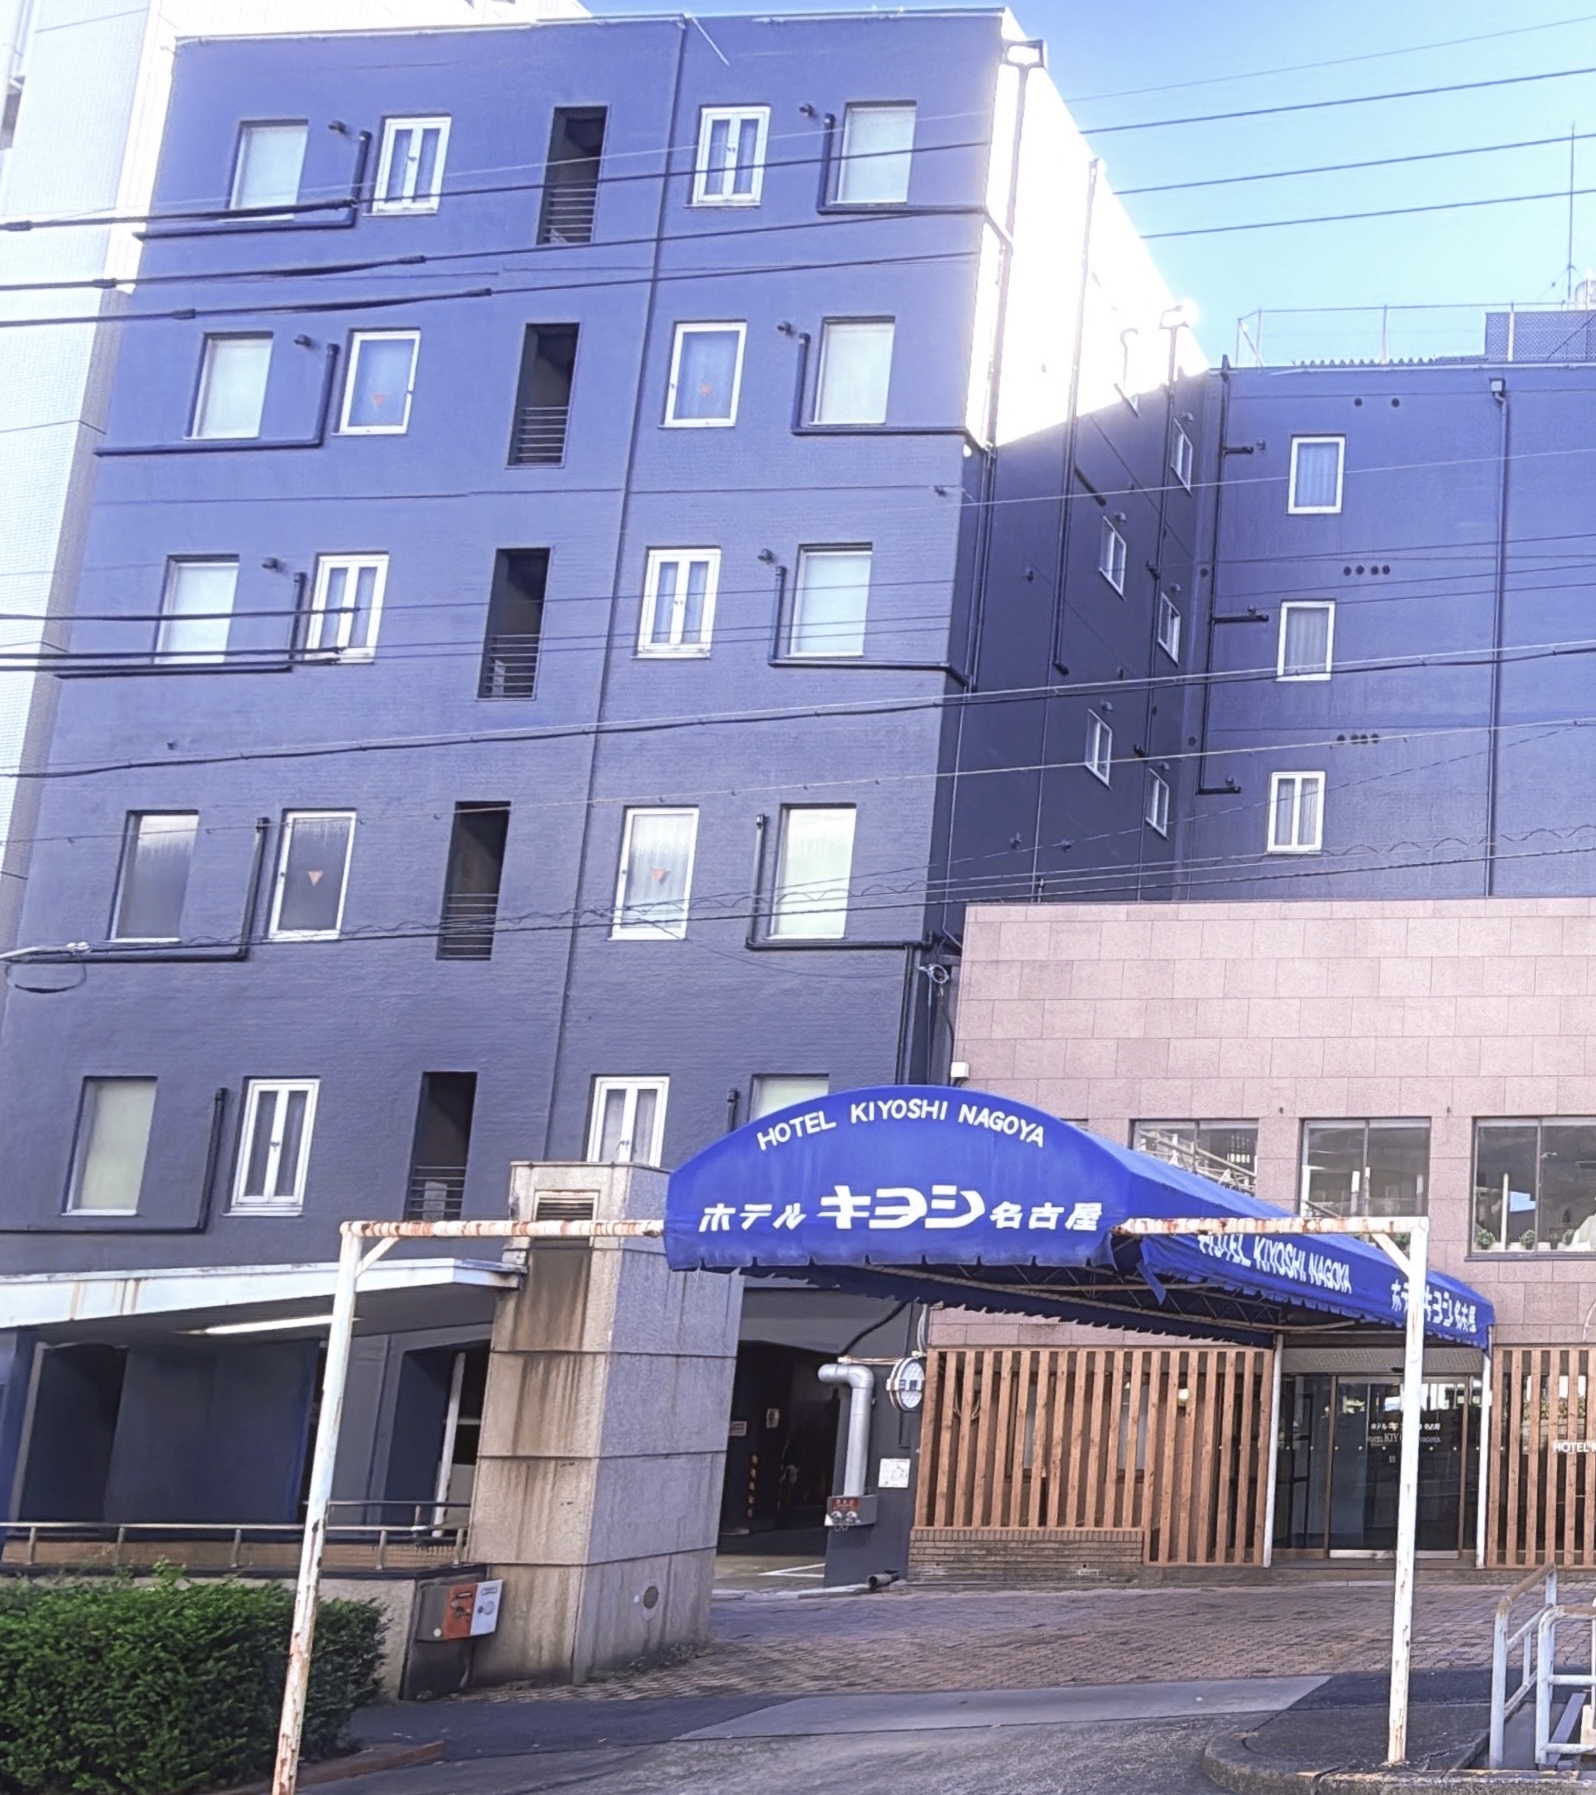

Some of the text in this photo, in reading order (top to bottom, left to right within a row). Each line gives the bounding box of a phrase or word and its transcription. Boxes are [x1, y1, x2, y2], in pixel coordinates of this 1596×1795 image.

[757, 1098, 1045, 1151] HOTEL KIYOSHI NAGOYA
[1253, 1235, 1307, 1283] KIYOSHI
[1308, 1252, 1353, 1295] NAGOYA
[1552, 1441, 1590, 1453] HOTEL
